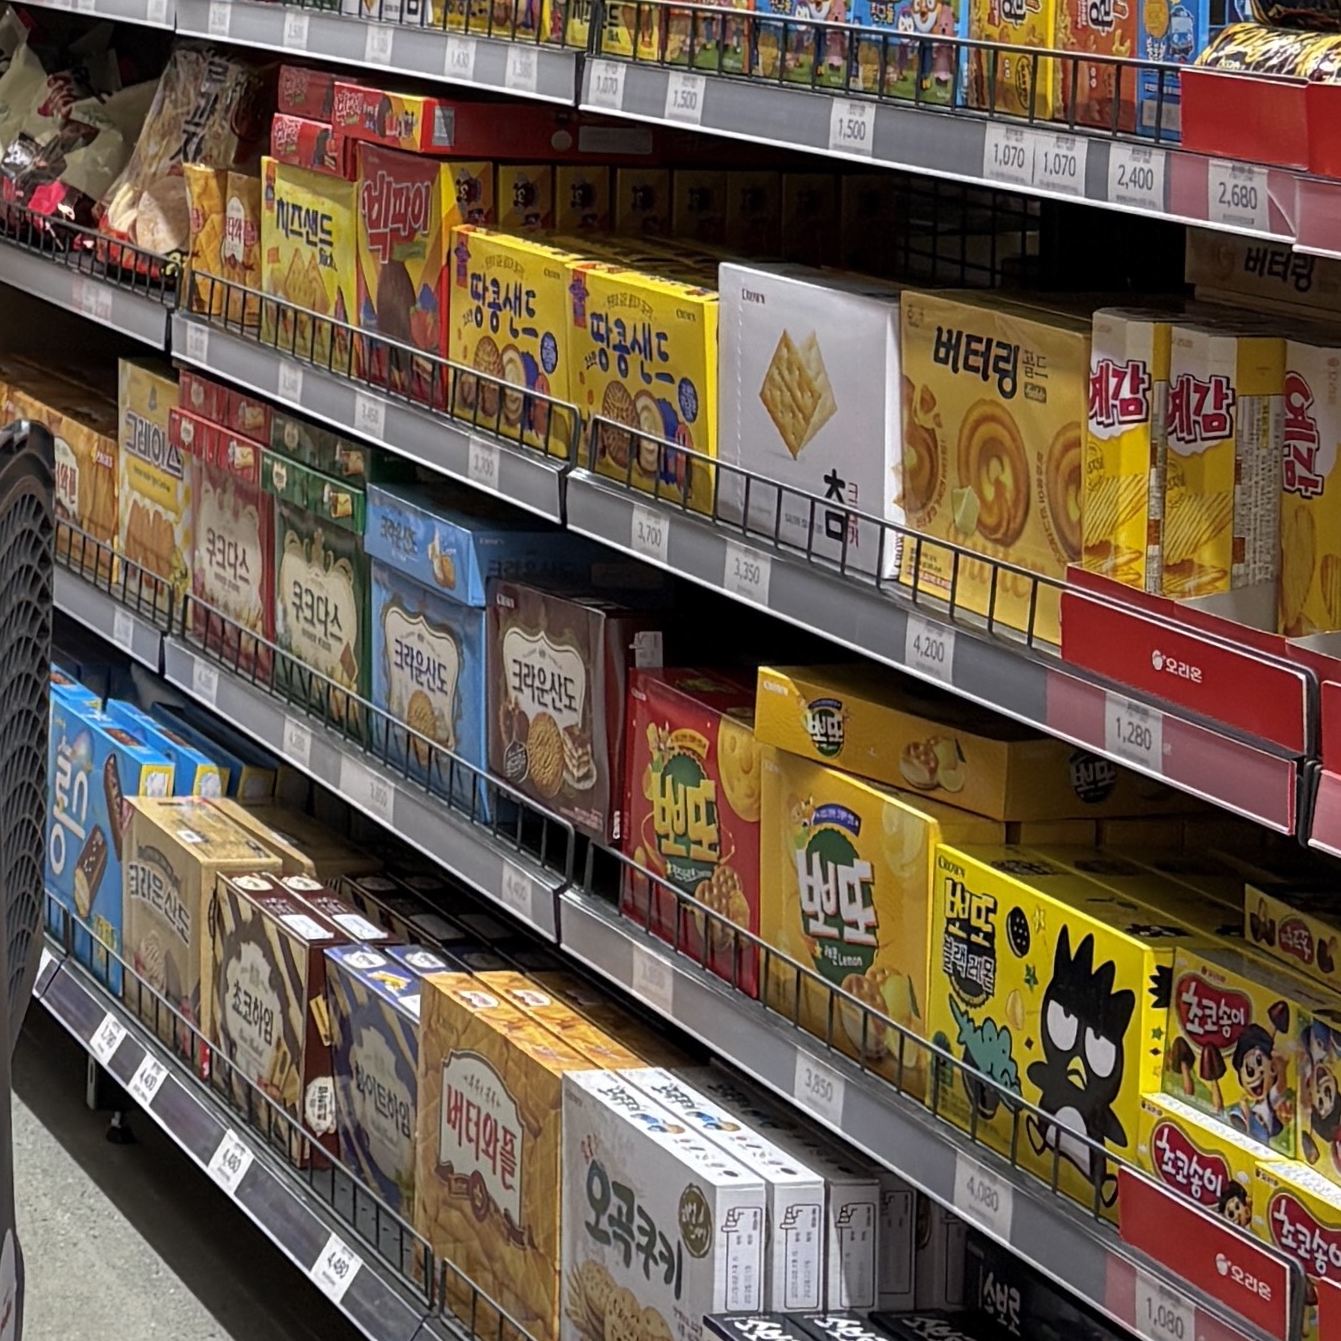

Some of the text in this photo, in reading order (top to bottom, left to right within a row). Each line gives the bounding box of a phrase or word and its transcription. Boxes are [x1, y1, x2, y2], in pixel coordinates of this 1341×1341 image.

[673, 87, 698, 112] 1,500
[837, 118, 867, 143] 1,500
[993, 143, 1025, 169] 1,070
[1043, 152, 1077, 178] 1,070
[1117, 165, 1154, 191] 2,400
[276, 196, 334, 249] 치즈샌드
[361, 169, 432, 265] 빅파이
[1218, 182, 1258, 211] 2,680
[1245, 245, 1315, 294] 버터링
[470, 270, 539, 339] 땅콩샌드
[590, 309, 676, 386] 땅콩샌드
[934, 326, 1020, 400] 버터링
[1023, 349, 1049, 379] 골드
[205, 528, 251, 584] 쿠크다스
[636, 521, 662, 548] 3,700
[734, 557, 760, 586] 3,350
[291, 580, 343, 645] 쿠크다스
[394, 638, 449, 697] 크라운산도
[912, 634, 944, 663] 4,200
[1166, 659, 1204, 684] 오리온
[512, 658, 578, 714] 크라운산도
[1115, 717, 1153, 751] 1,280
[653, 770, 719, 863] 뽀또
[128, 861, 192, 947] 크라운산도
[796, 849, 878, 948] 뽀또
[944, 877, 998, 947] 뽀또
[833, 950, 864, 968] Lemon
[232, 978, 275, 1043] 초코하임
[1181, 980, 1247, 1036] 초코송이
[354, 1060, 413, 1140] 화이트하임
[803, 1064, 835, 1104] 3,850
[446, 1081, 518, 1193] 버터와플
[1156, 1126, 1223, 1198] 초코송이
[966, 1176, 999, 1215] 4,080
[584, 1158, 684, 1302] 오곡쿠키
[1230, 1266, 1272, 1301] 오리온
[1145, 1293, 1186, 1341] 1,080
